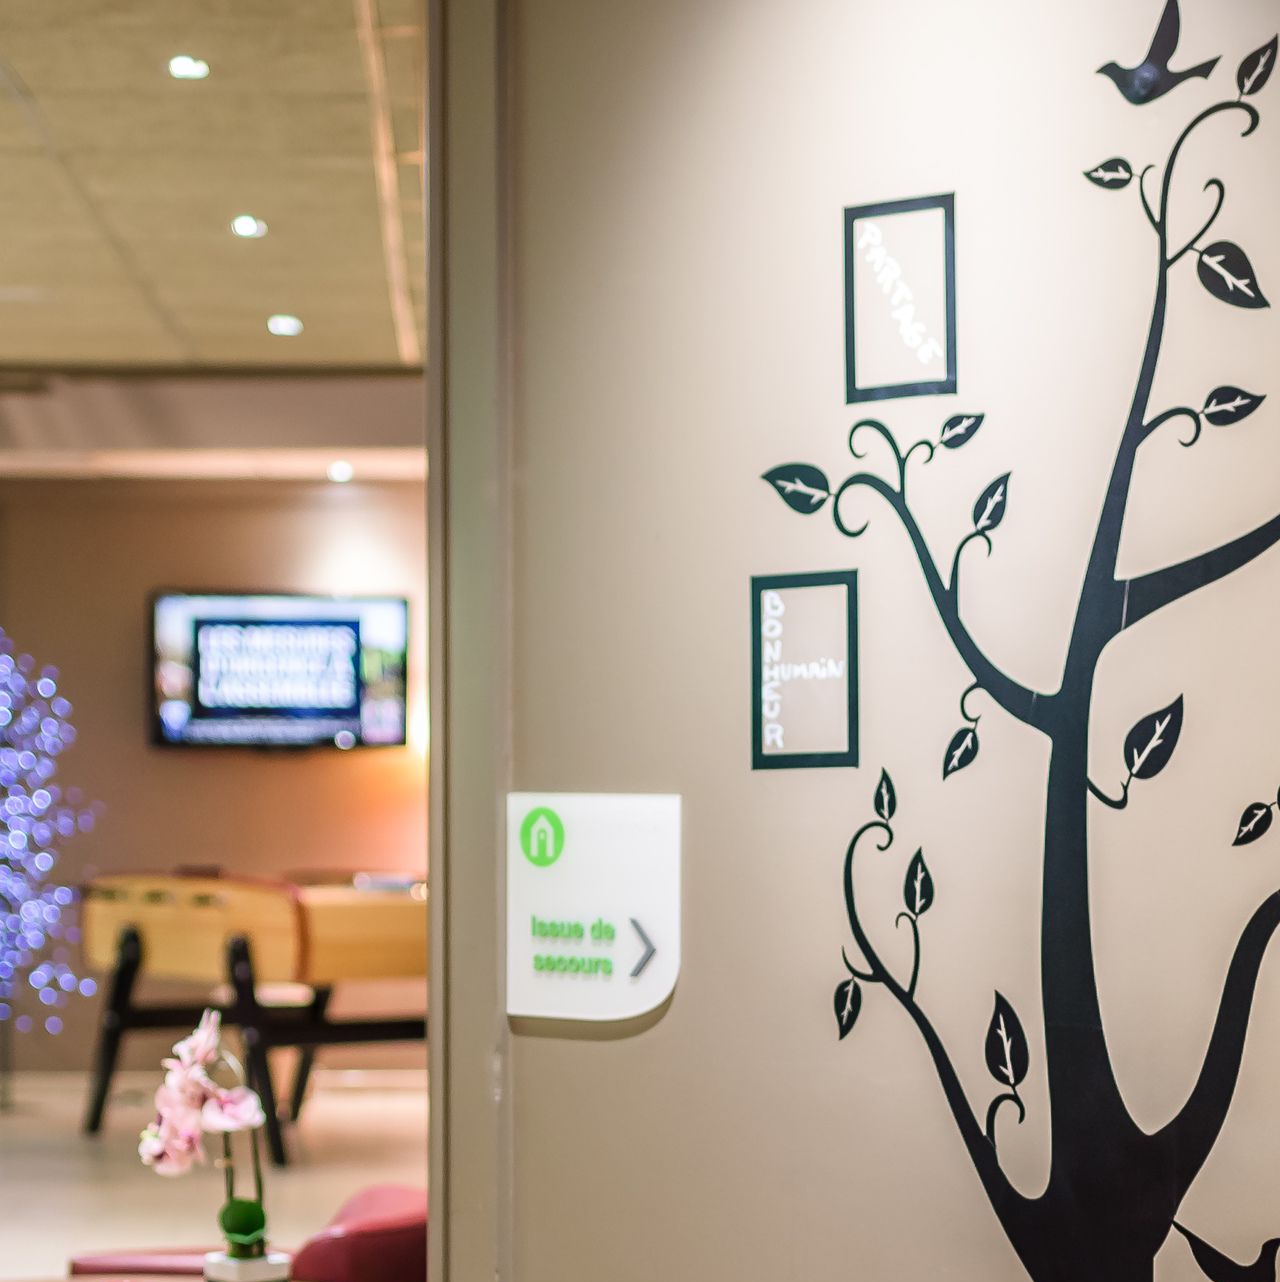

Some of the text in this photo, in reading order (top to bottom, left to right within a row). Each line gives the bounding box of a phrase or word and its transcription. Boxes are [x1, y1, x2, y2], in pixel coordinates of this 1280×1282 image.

[762, 590, 785, 749] BONHEUR
[531, 913, 616, 941] Issue de
[533, 954, 613, 976] secours
